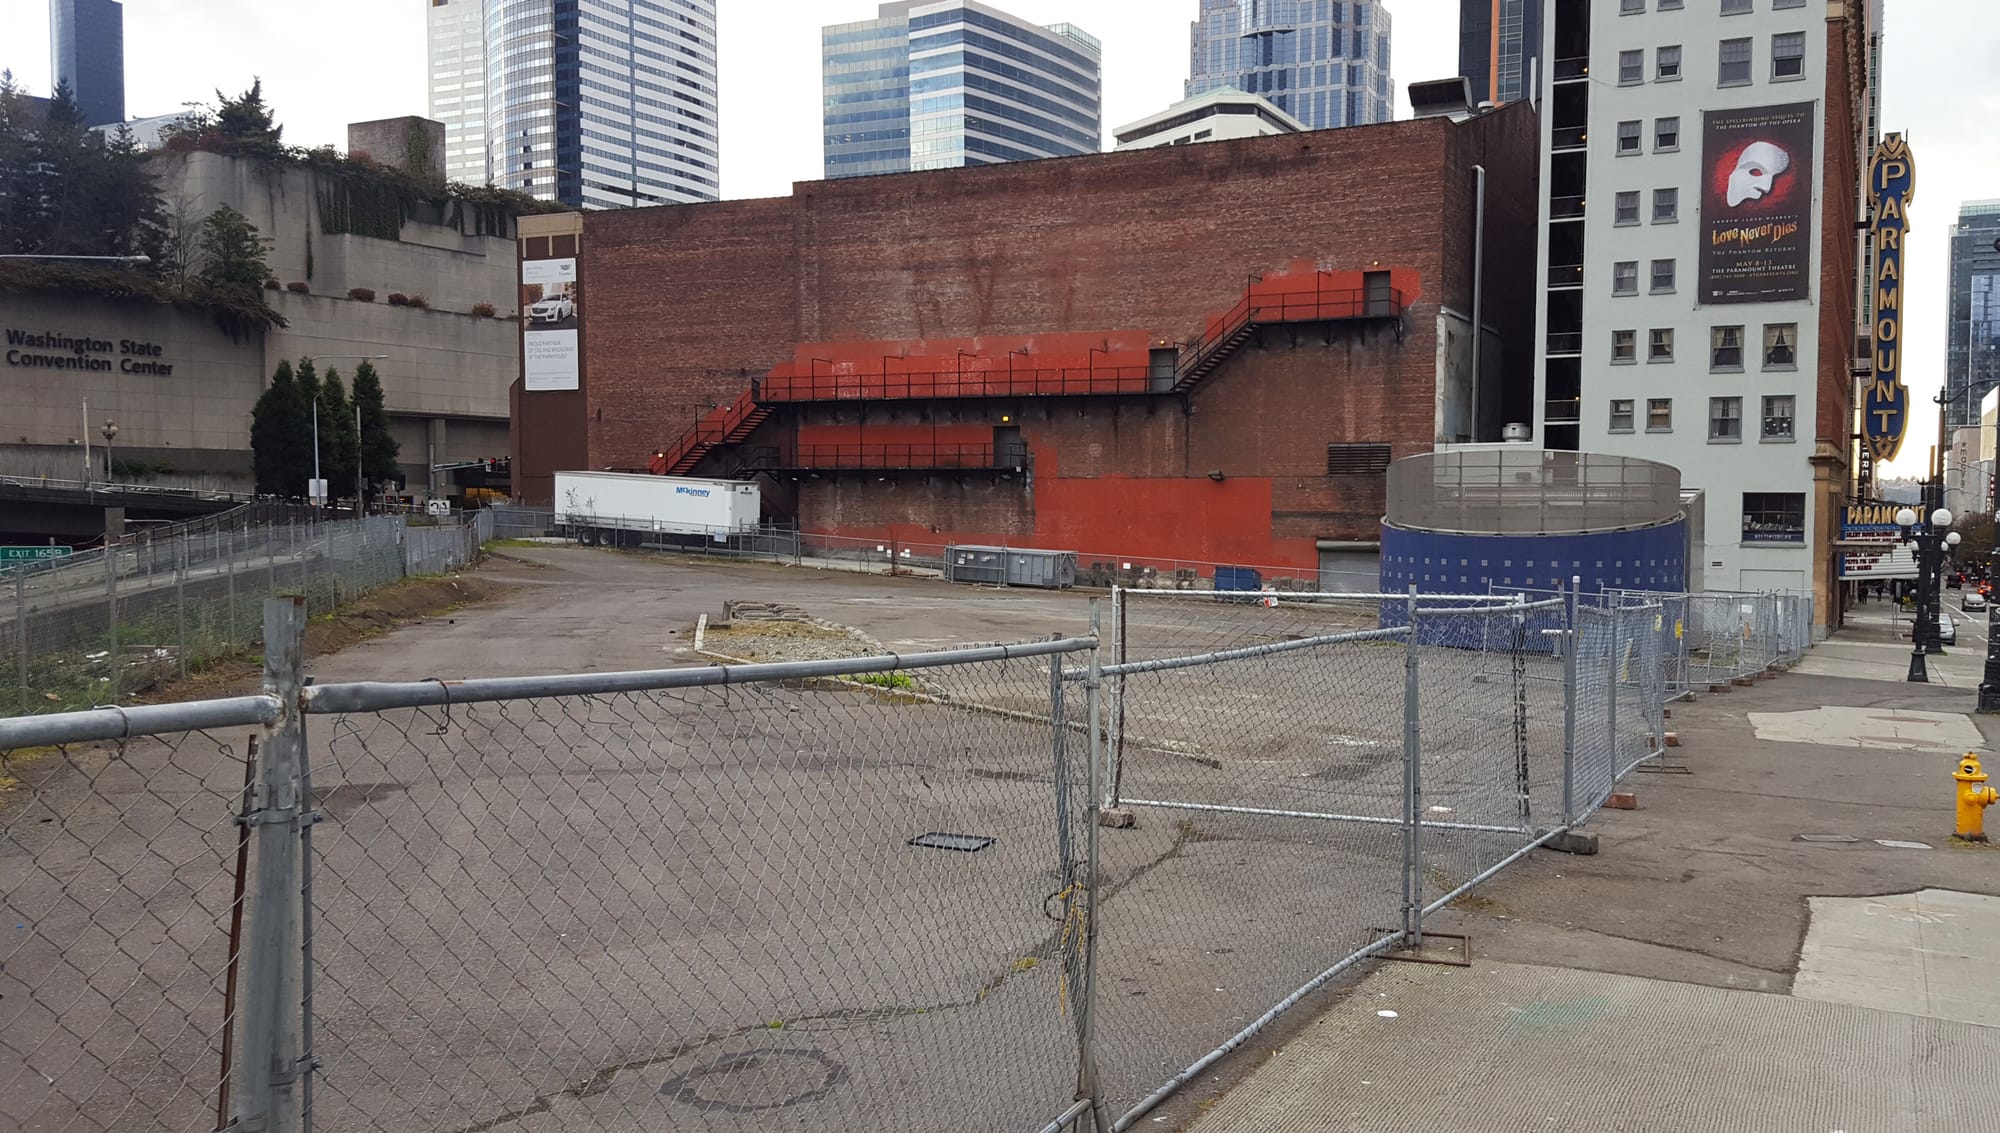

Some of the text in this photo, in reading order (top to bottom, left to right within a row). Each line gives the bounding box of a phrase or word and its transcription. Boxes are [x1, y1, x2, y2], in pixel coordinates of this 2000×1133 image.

[1712, 221, 1797, 248] Love Never Dies
[1872, 162, 1906, 433] PARAMOUNT
[6, 329, 163, 356] Washington State
[6, 350, 174, 375] Convention Center
[1847, 505, 1926, 525] PARAMONT
[8, 549, 30, 558] EXIT
